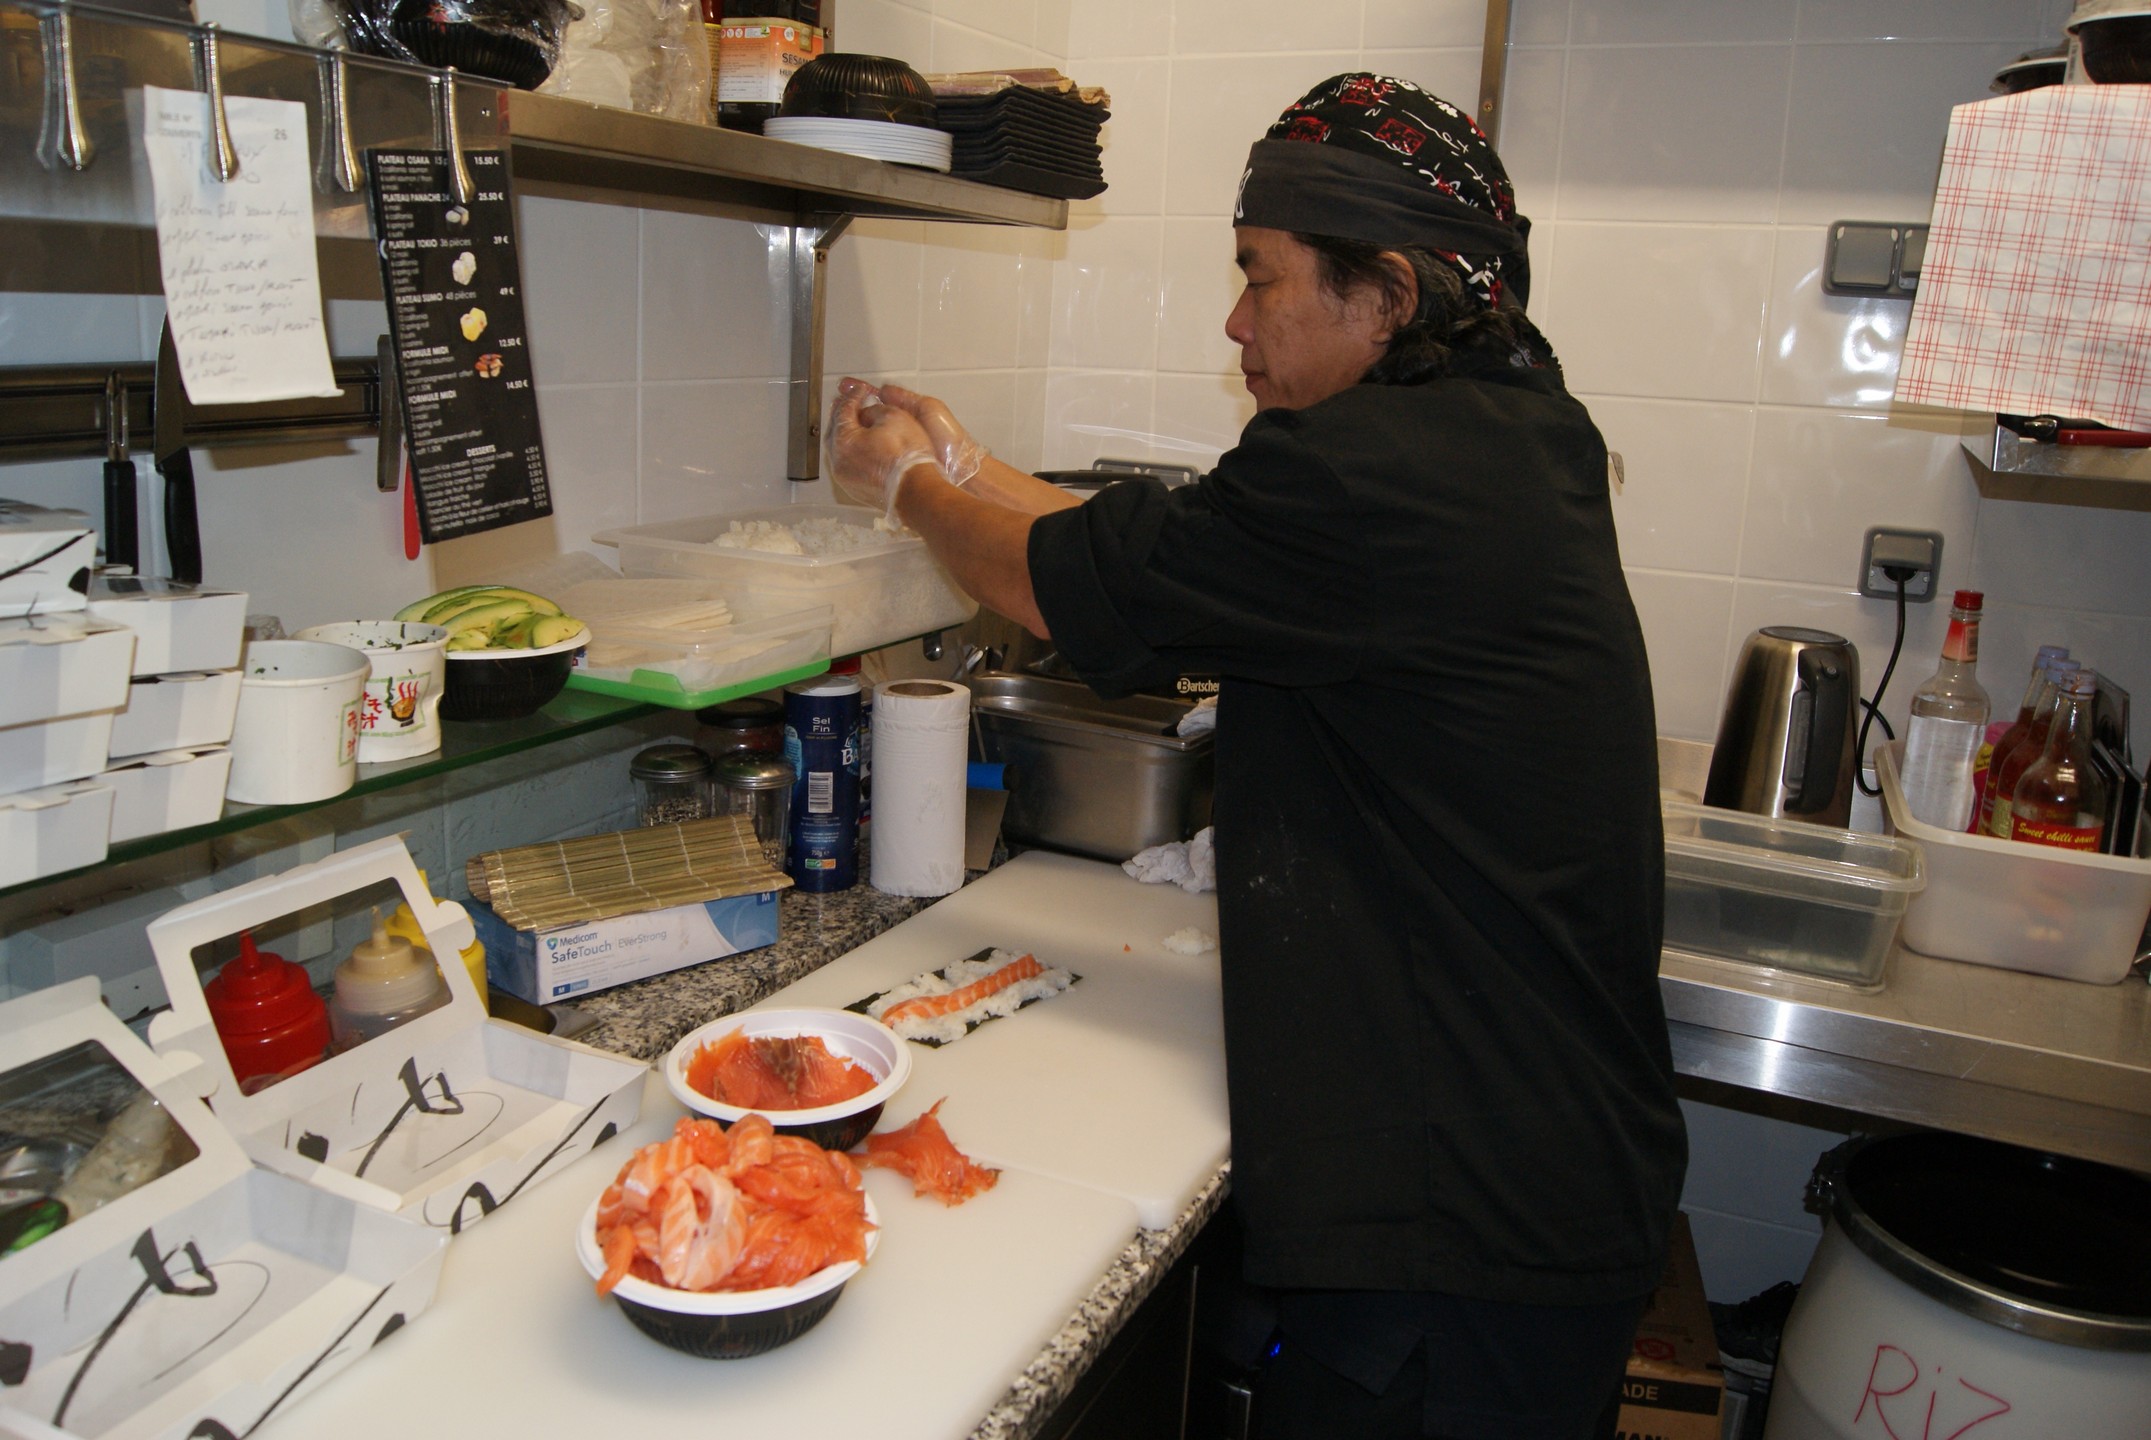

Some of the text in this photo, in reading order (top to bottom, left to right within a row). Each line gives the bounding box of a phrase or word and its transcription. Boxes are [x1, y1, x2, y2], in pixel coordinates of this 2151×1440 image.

[274, 128, 287, 140] 26
[812, 717, 830, 725] Sel
[812, 725, 830, 733] Fin
[2018, 822, 2045, 839] Sweet
[2046, 831, 2073, 843] chilli
[560, 931, 598, 947] Medicom
[551, 930, 668, 964] SafeTouch EverStrong
